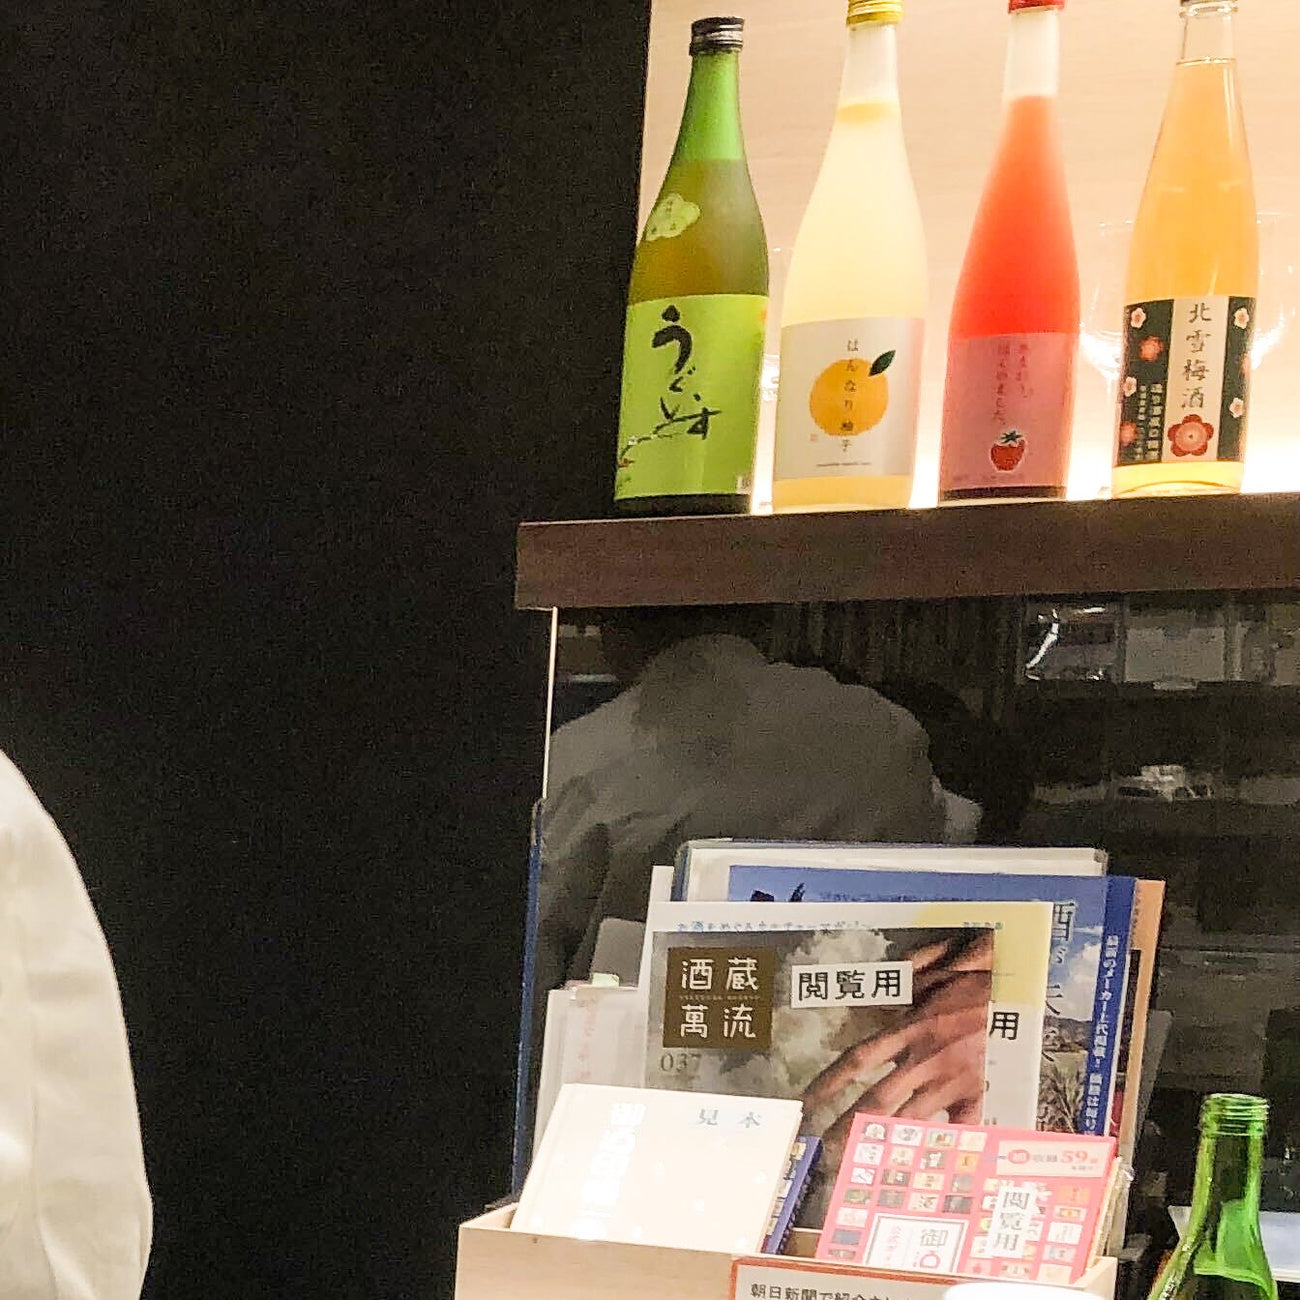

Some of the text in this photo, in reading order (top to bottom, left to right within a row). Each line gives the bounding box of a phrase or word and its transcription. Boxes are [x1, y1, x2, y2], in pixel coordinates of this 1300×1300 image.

[1181, 302, 1212, 409] 北雪梅酒
[681, 957, 759, 991] 酒蔵
[798, 969, 901, 1001] 閲覧用
[680, 1003, 757, 1039] 萬流
